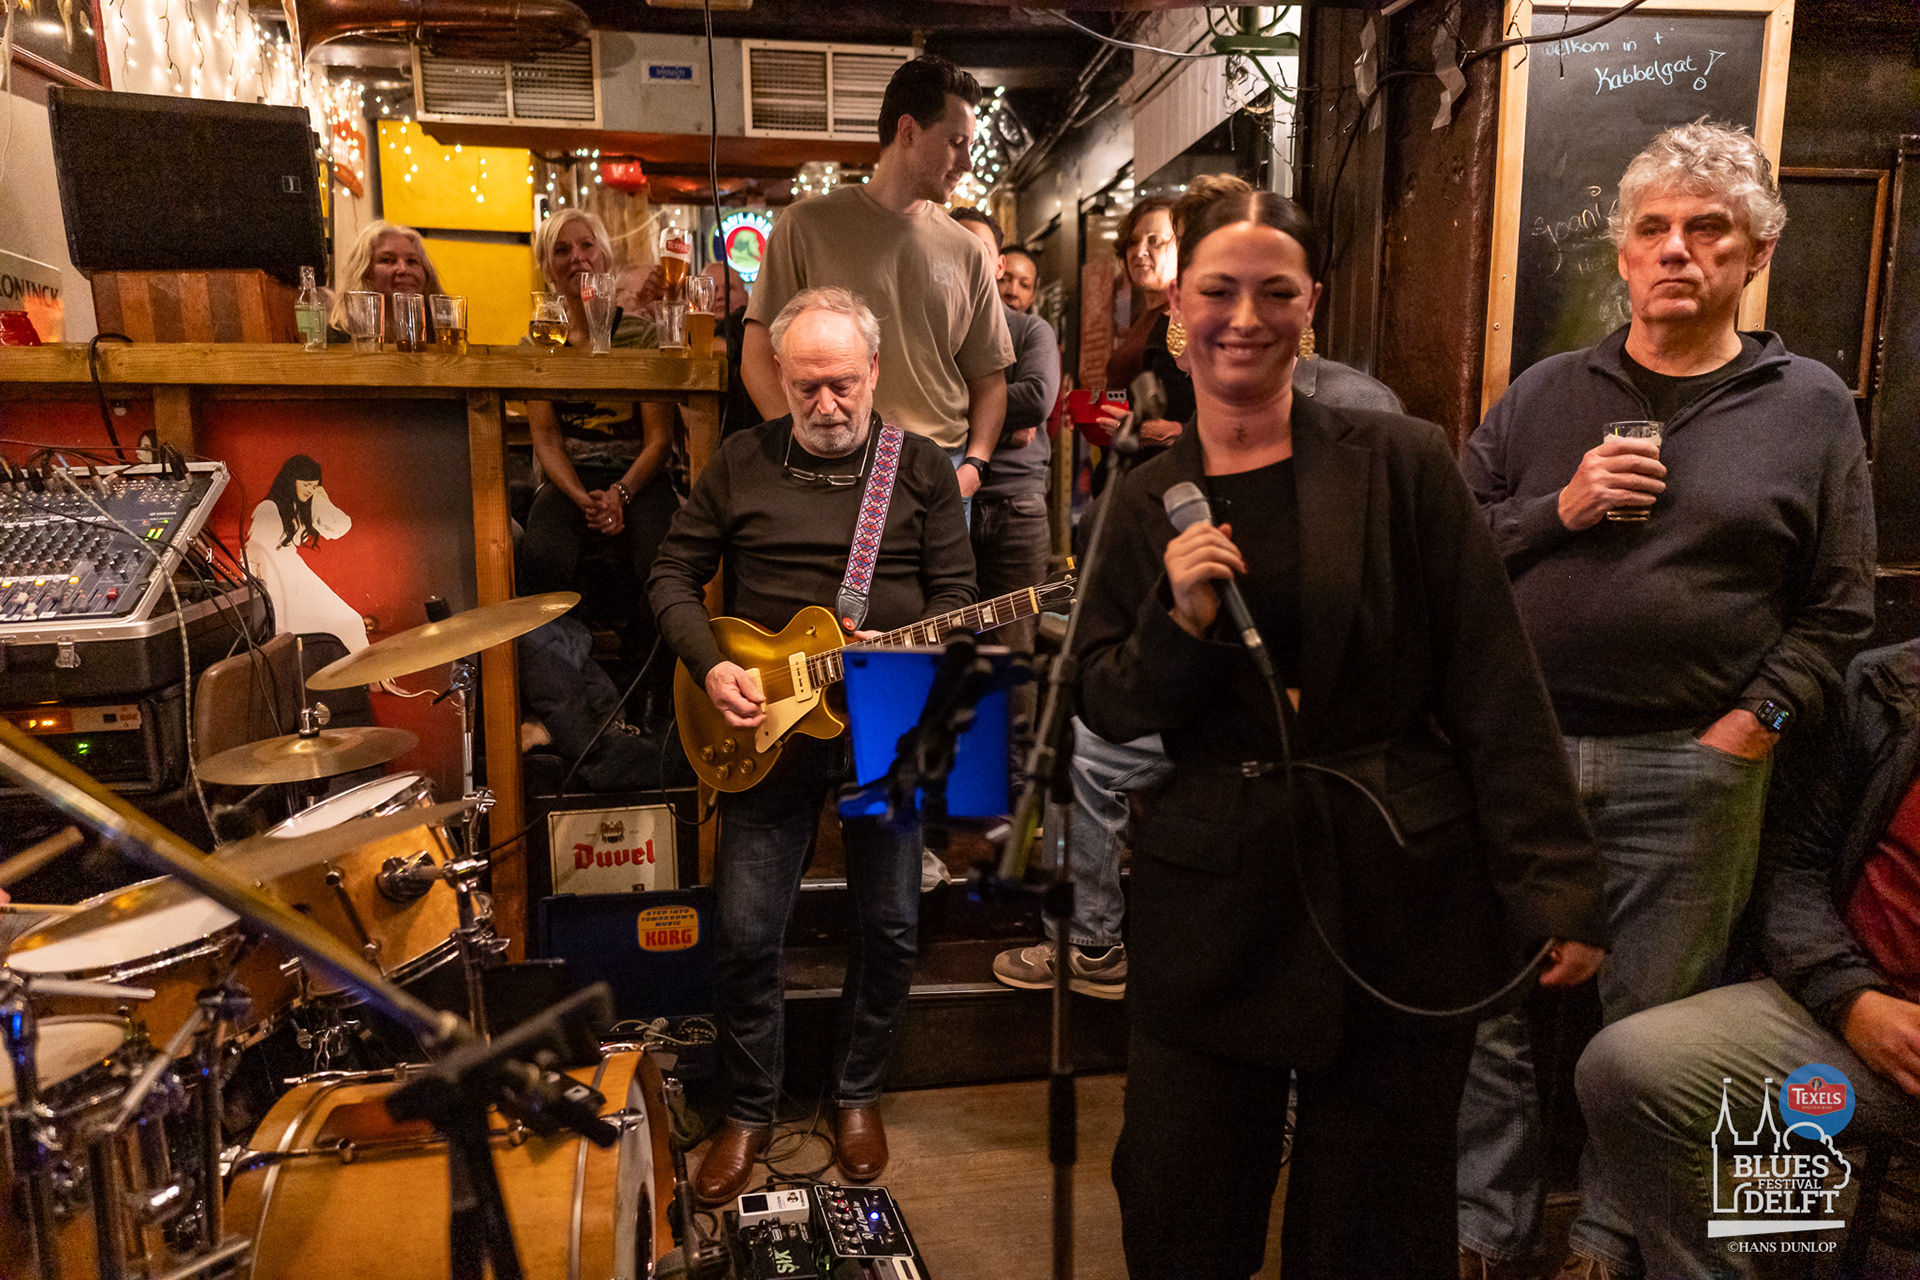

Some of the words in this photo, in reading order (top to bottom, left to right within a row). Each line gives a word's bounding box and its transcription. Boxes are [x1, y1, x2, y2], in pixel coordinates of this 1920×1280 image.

[1623, 37, 1637, 51] in
[0, 274, 61, 311] ONINCK
[572, 838, 656, 870] Duvel
[645, 929, 693, 947] KORG
